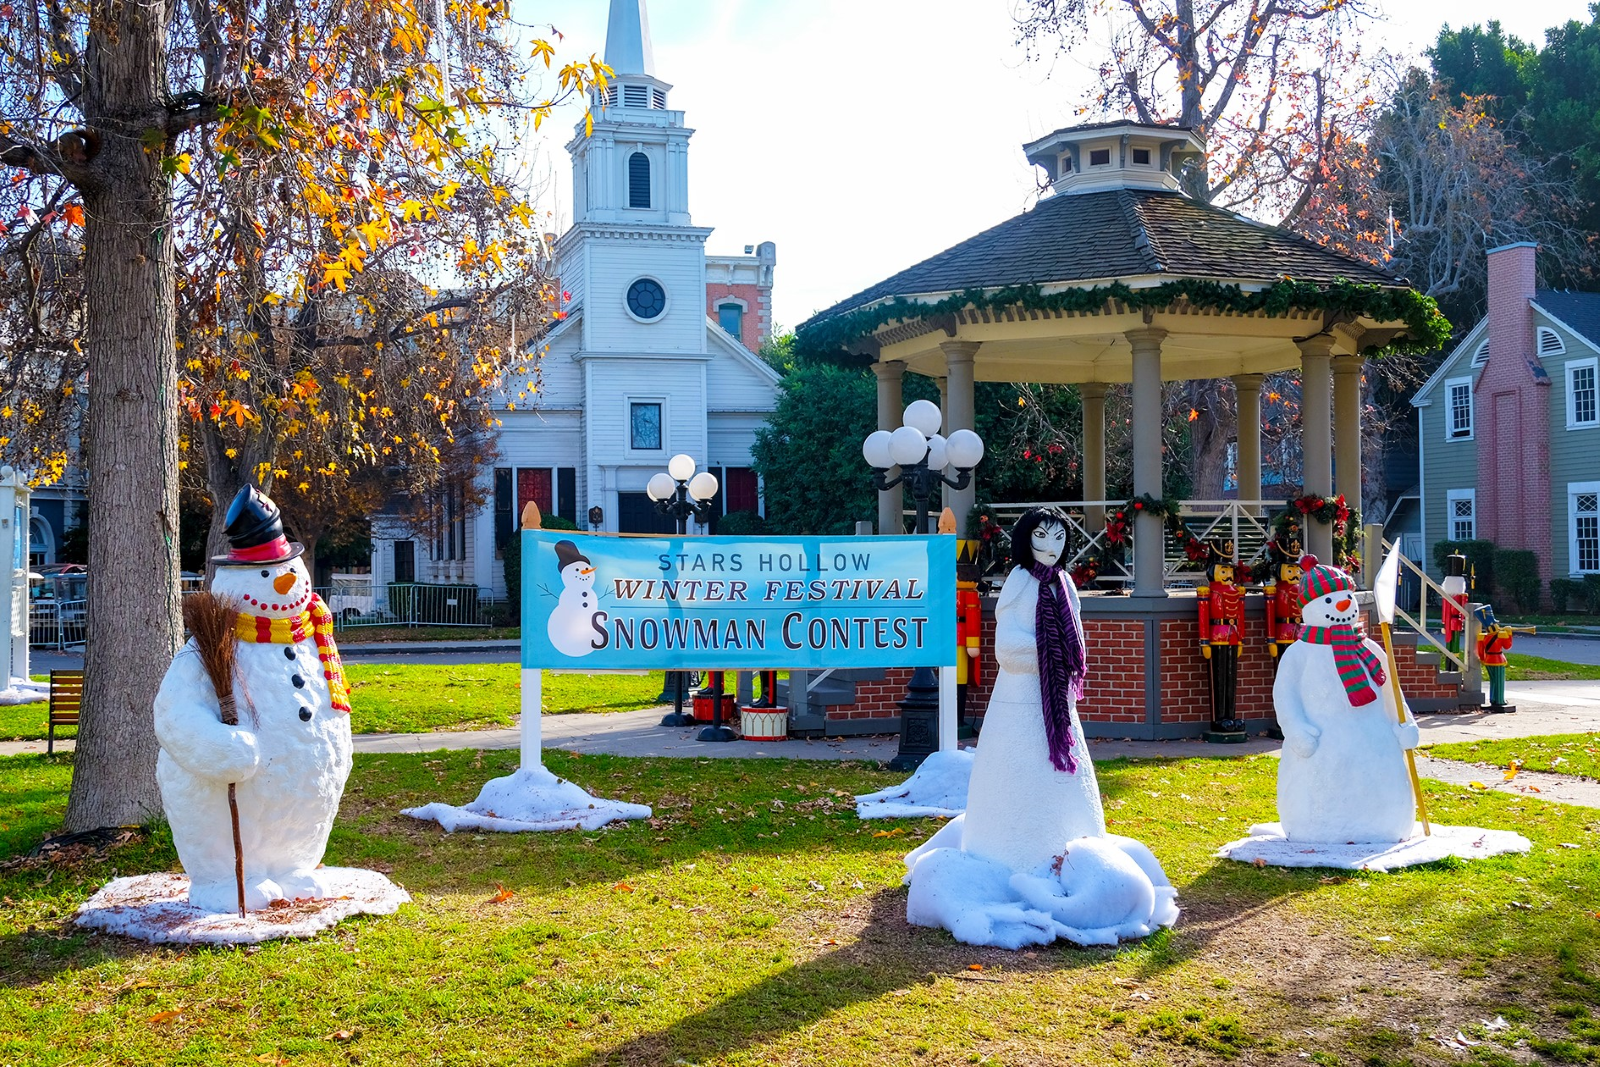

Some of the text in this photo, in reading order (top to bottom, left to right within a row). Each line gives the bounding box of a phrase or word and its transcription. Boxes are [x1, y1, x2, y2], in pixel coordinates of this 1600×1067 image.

[657, 553, 871, 572] STARS HOLLOW
[613, 578, 925, 602] WINTER FESTIVAL
[590, 610, 929, 651] SNOWMAN CONTEST
